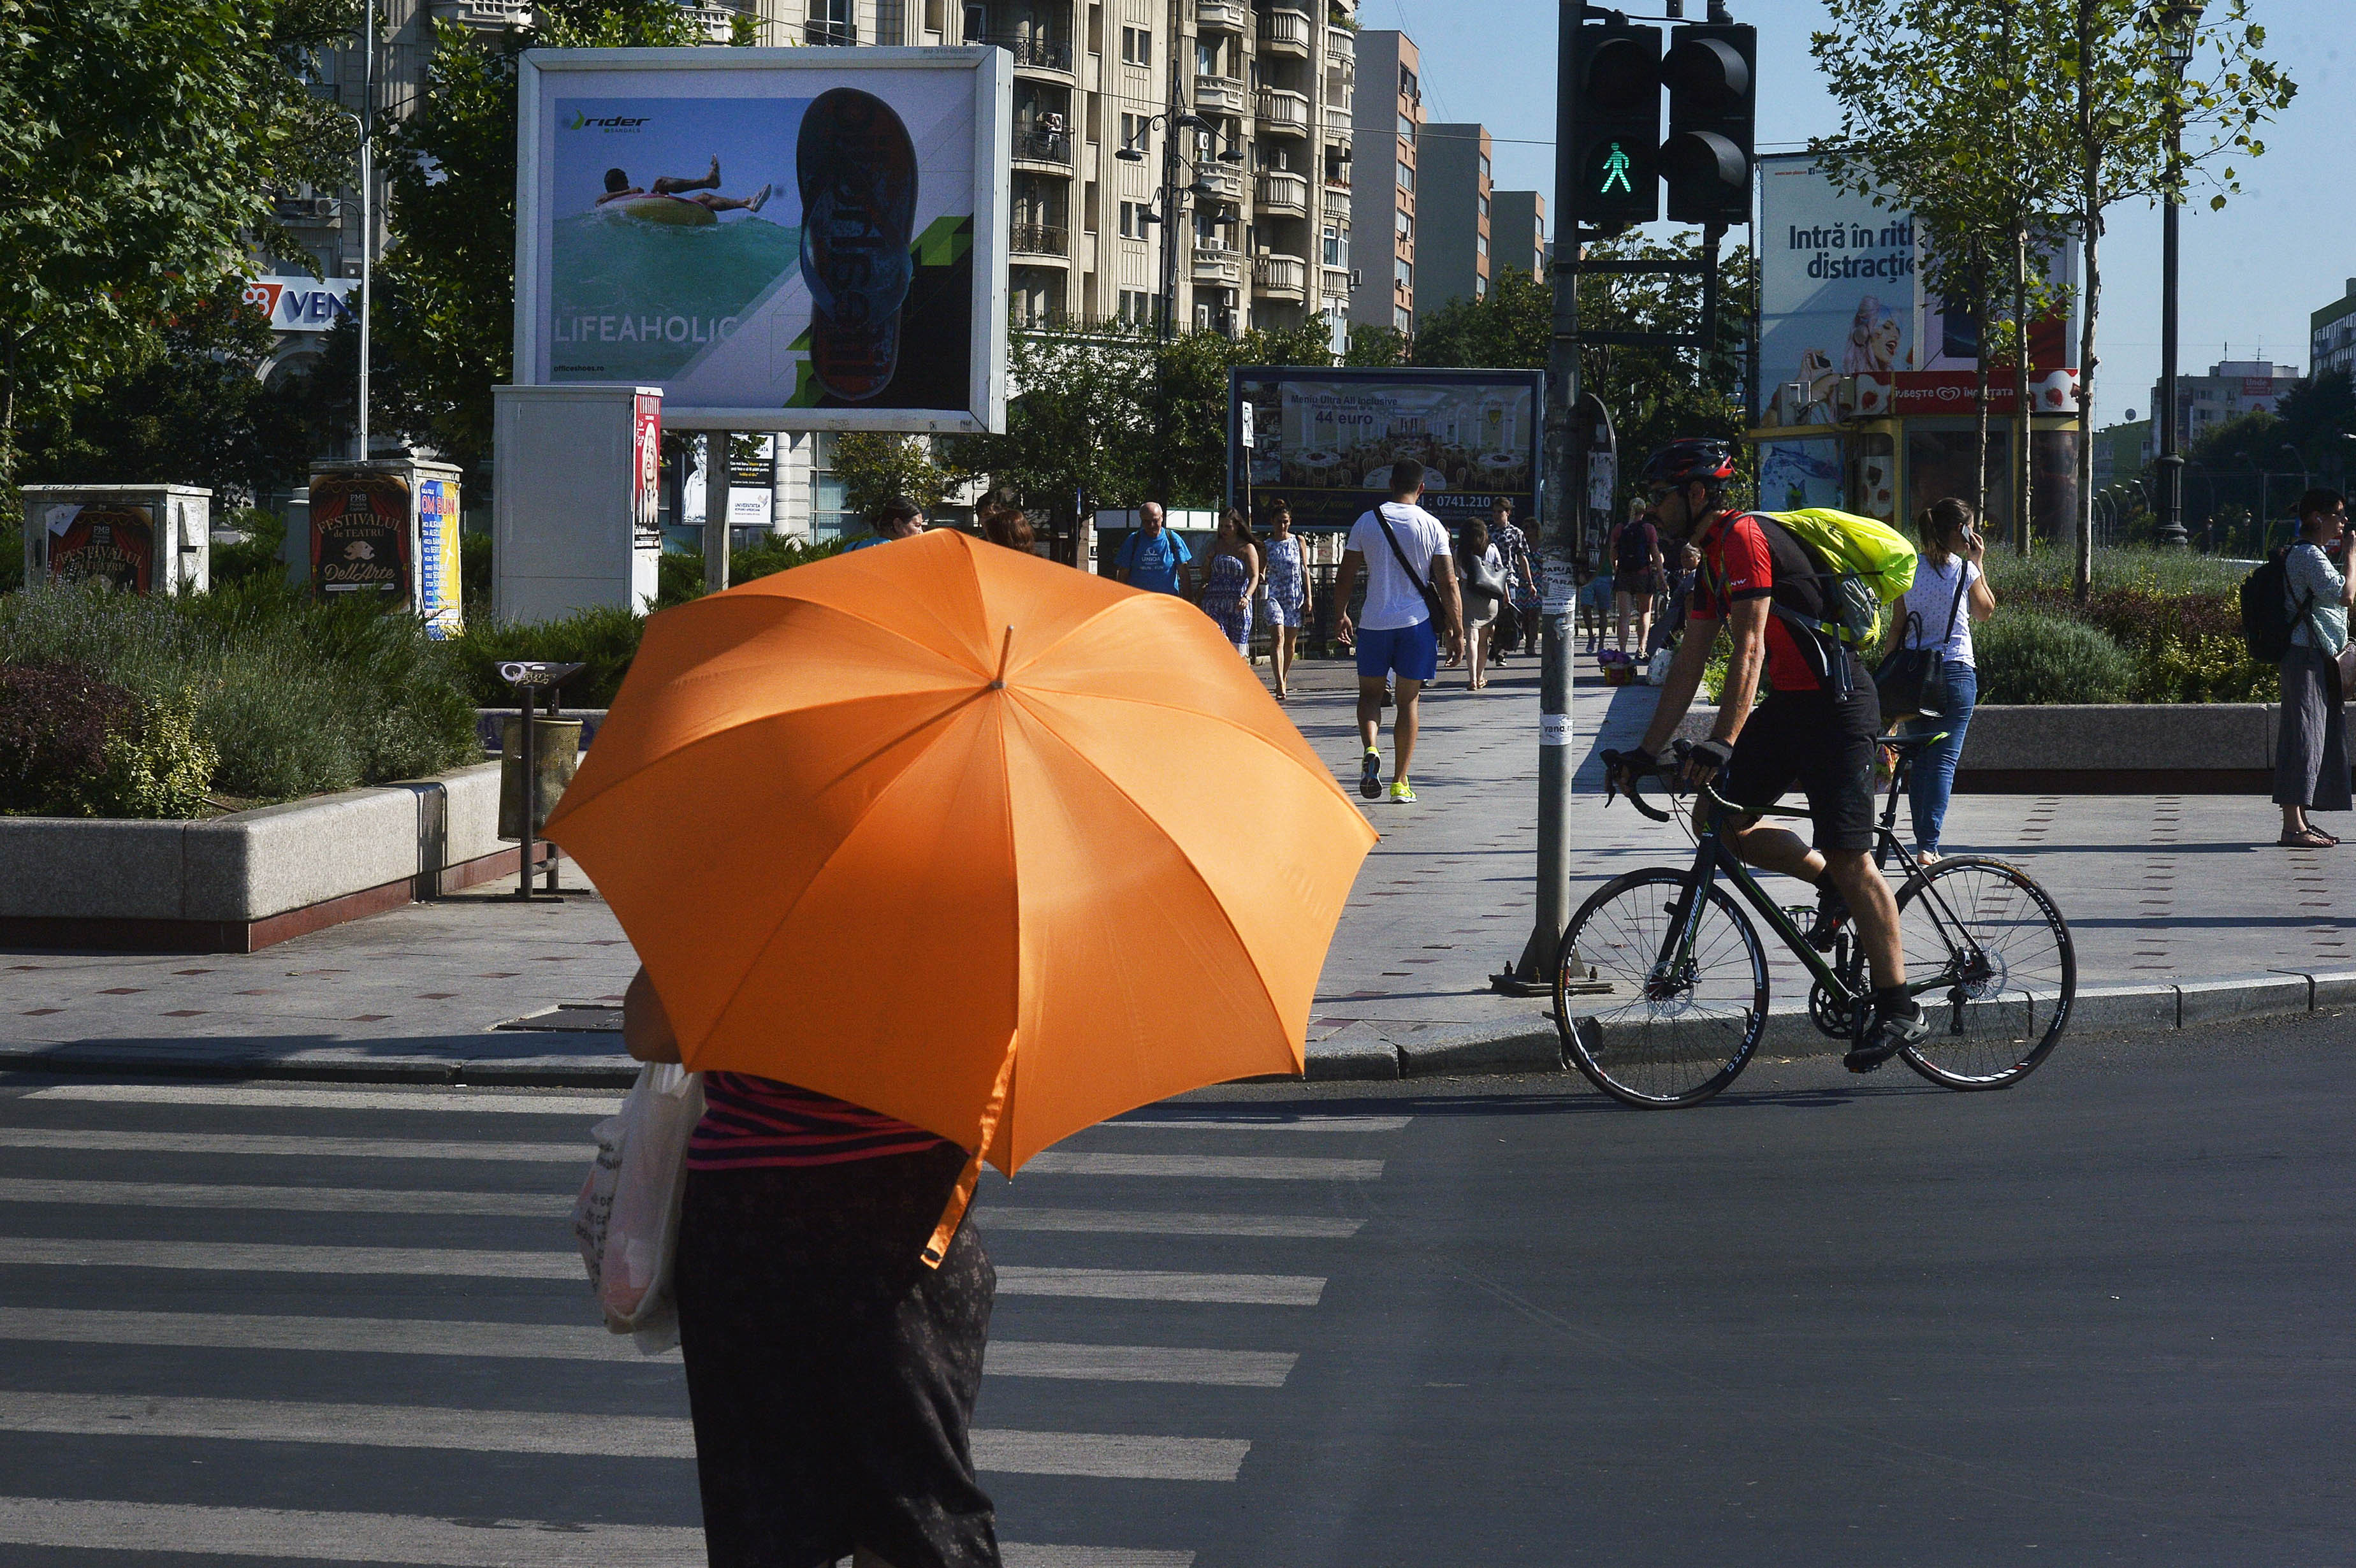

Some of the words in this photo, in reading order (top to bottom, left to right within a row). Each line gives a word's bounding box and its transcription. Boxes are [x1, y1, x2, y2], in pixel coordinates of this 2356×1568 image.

[585, 115, 651, 126] rider
[1790, 222, 1845, 249] Intră
[1851, 223, 1873, 248] în
[555, 316, 738, 342] LIFEAHOLIC
[1291, 395, 1318, 403] Meniu
[1320, 395, 1341, 404] Ultra
[1343, 396, 1355, 405] All
[1358, 396, 1397, 405] Inclusive
[1316, 410, 1333, 423] 44
[1339, 414, 1373, 425] euro
[422, 495, 435, 514] OM
[437, 497, 454, 516] BUN
[1437, 495, 1490, 507] 0741.210
[317, 513, 401, 534] FESTIVALUL
[333, 529, 343, 537] de
[345, 528, 384, 537] TEATRU
[324, 563, 395, 581] Dell'Arte
[1683, 885, 1702, 943] MERIDA
[1727, 1012, 1760, 1072] DIABLO
